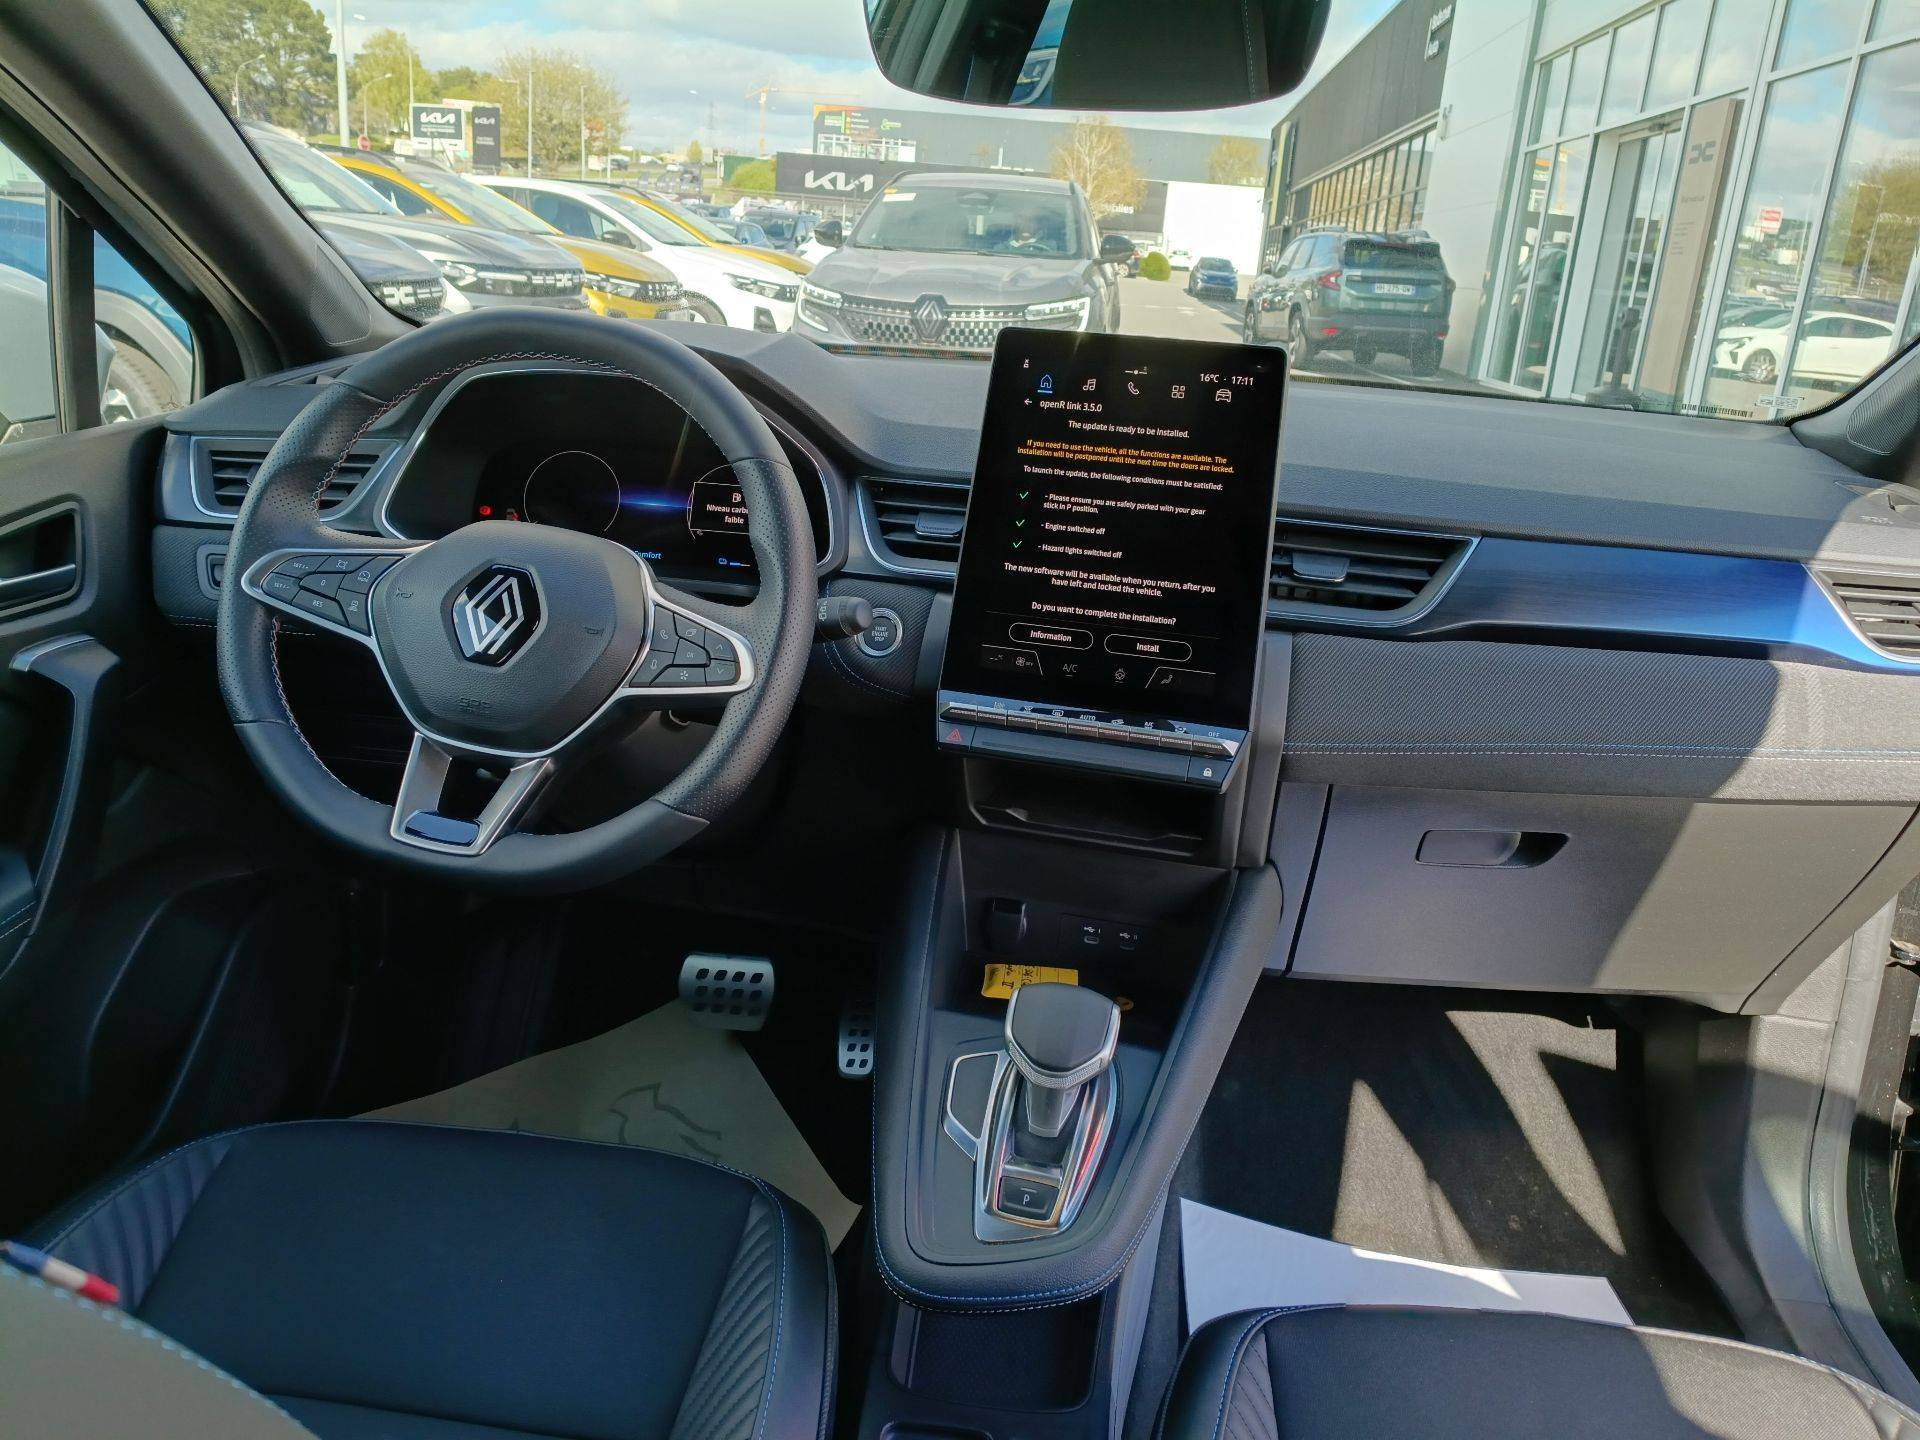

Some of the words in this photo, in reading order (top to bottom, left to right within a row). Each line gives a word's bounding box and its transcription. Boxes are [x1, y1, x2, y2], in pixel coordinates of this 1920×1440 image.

[420, 112, 456, 124] KIA
[804, 170, 874, 192] KIA
[1200, 374, 1220, 383] 16°C
[1231, 376, 1254, 386] 17:11
[1040, 400, 1066, 410] openR
[1066, 402, 1082, 410] link
[1083, 402, 1102, 412] 3.5.0
[1068, 420, 1082, 429] The
[1082, 422, 1108, 432] update
[1108, 423, 1114, 431] is
[1116, 425, 1136, 435] ready
[1137, 426, 1144, 434] to
[1146, 426, 1156, 435] be
[1074, 453, 1108, 462] postponed
[1152, 459, 1168, 467] time
[1168, 460, 1180, 468] the
[1140, 450, 1170, 459] functions
[1214, 456, 1227, 464] The
[1032, 466, 1052, 475] launch
[1102, 472, 1132, 483] following
[1132, 477, 1164, 486] conditions
[706, 504, 730, 512] Niveau
[1043, 502, 1058, 510] stick
[1049, 494, 1070, 502] Please
[1116, 500, 1136, 510] safely
[1136, 502, 1158, 510] parked
[1160, 504, 1174, 512] with
[724, 516, 744, 524] faible
[1045, 522, 1066, 532] Engine
[1067, 525, 1095, 534] switched
[1042, 544, 1064, 553] Hazard
[1064, 546, 1082, 555] lights
[1084, 548, 1112, 558] switched
[1004, 562, 1018, 571] The
[1034, 566, 1064, 576] software
[1065, 570, 1078, 578] will
[1079, 571, 1088, 579] be
[1088, 573, 1120, 582] available
[1122, 576, 1142, 584] when
[1182, 582, 1200, 591] after
[1201, 585, 1216, 594] you
[1051, 578, 1068, 586] have
[1070, 579, 1082, 588] left
[1082, 582, 1097, 590] and
[1098, 582, 1122, 592] locked
[1122, 584, 1134, 594] the
[1032, 601, 1042, 610] Do
[1042, 604, 1056, 612] you
[1084, 609, 1118, 619] complete
[1119, 612, 1131, 620] the
[1030, 630, 1072, 642] Information
[1136, 642, 1160, 652] Install
[1062, 664, 1078, 672] A/C
[1023, 1194, 1030, 1204] P
